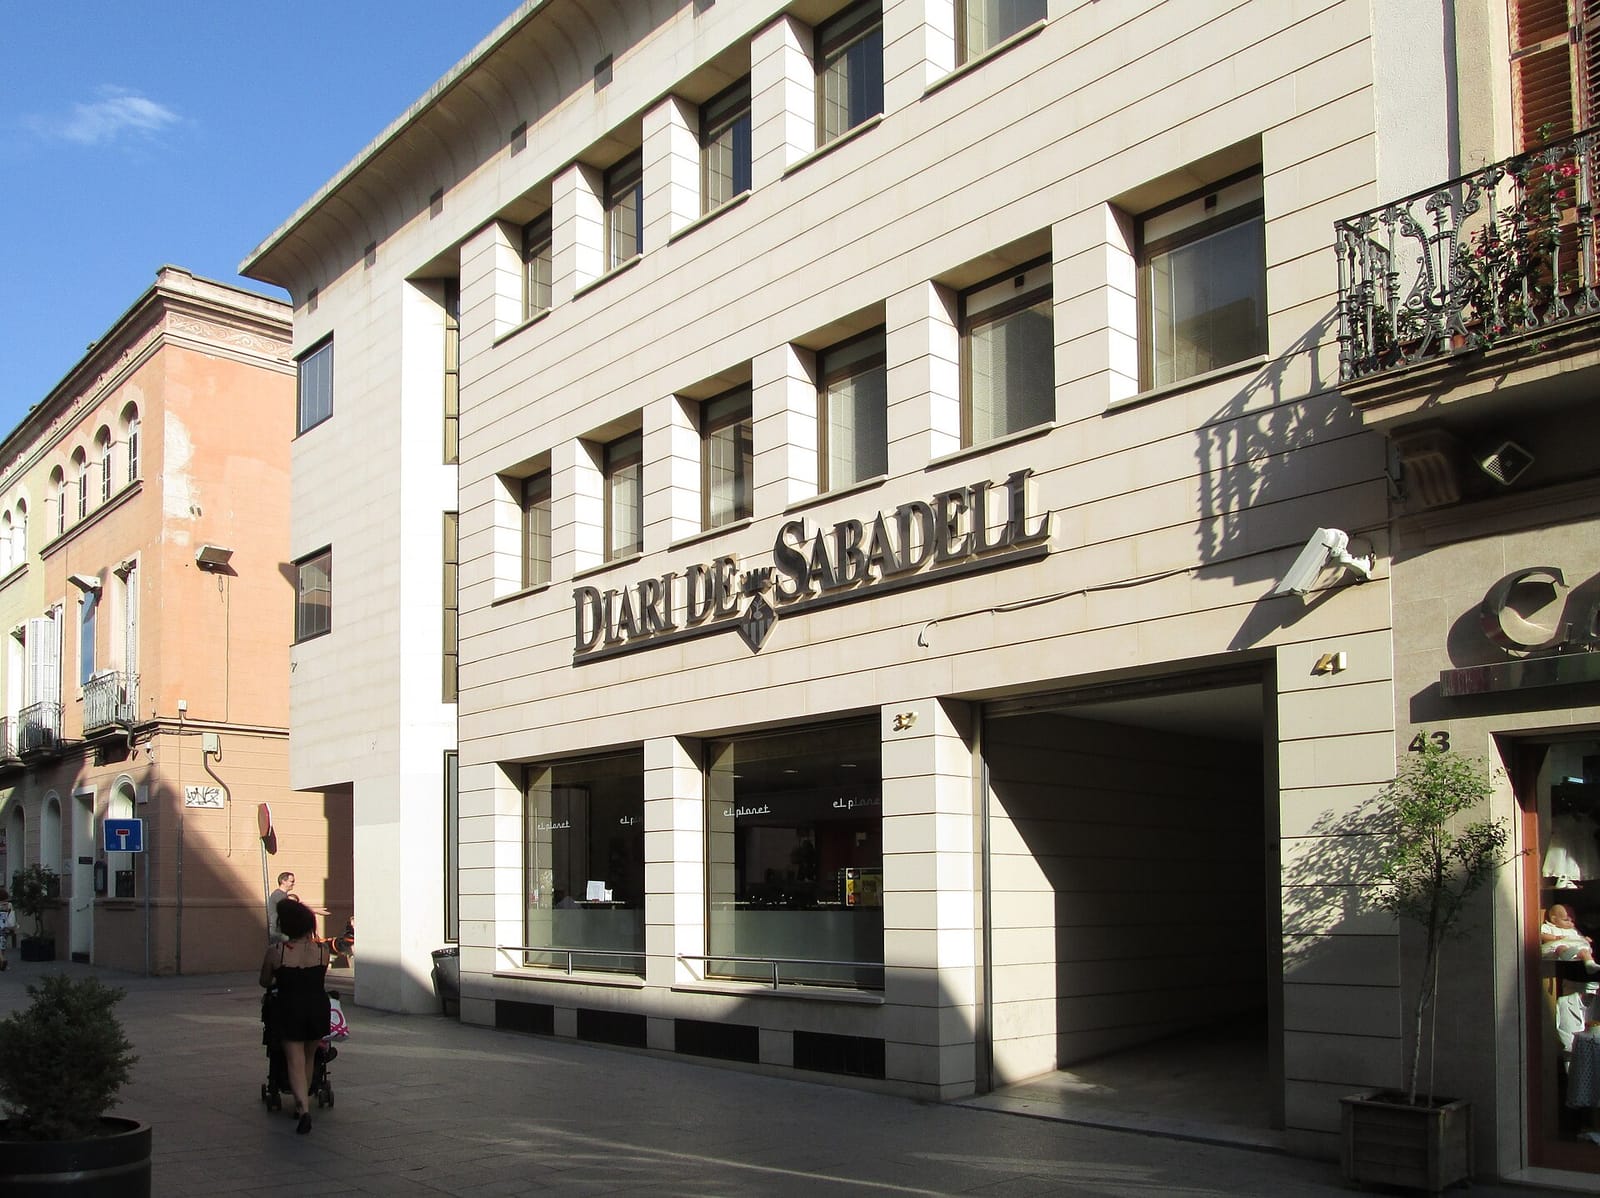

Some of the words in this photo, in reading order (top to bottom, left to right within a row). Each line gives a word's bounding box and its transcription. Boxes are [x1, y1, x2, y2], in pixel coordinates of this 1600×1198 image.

[572, 571, 678, 656] DIARI
[686, 553, 740, 628] DE
[772, 468, 1052, 604] SABADELL
[1310, 651, 1347, 676] 41
[1408, 730, 1450, 753] 43
[735, 804, 771, 818] planet
